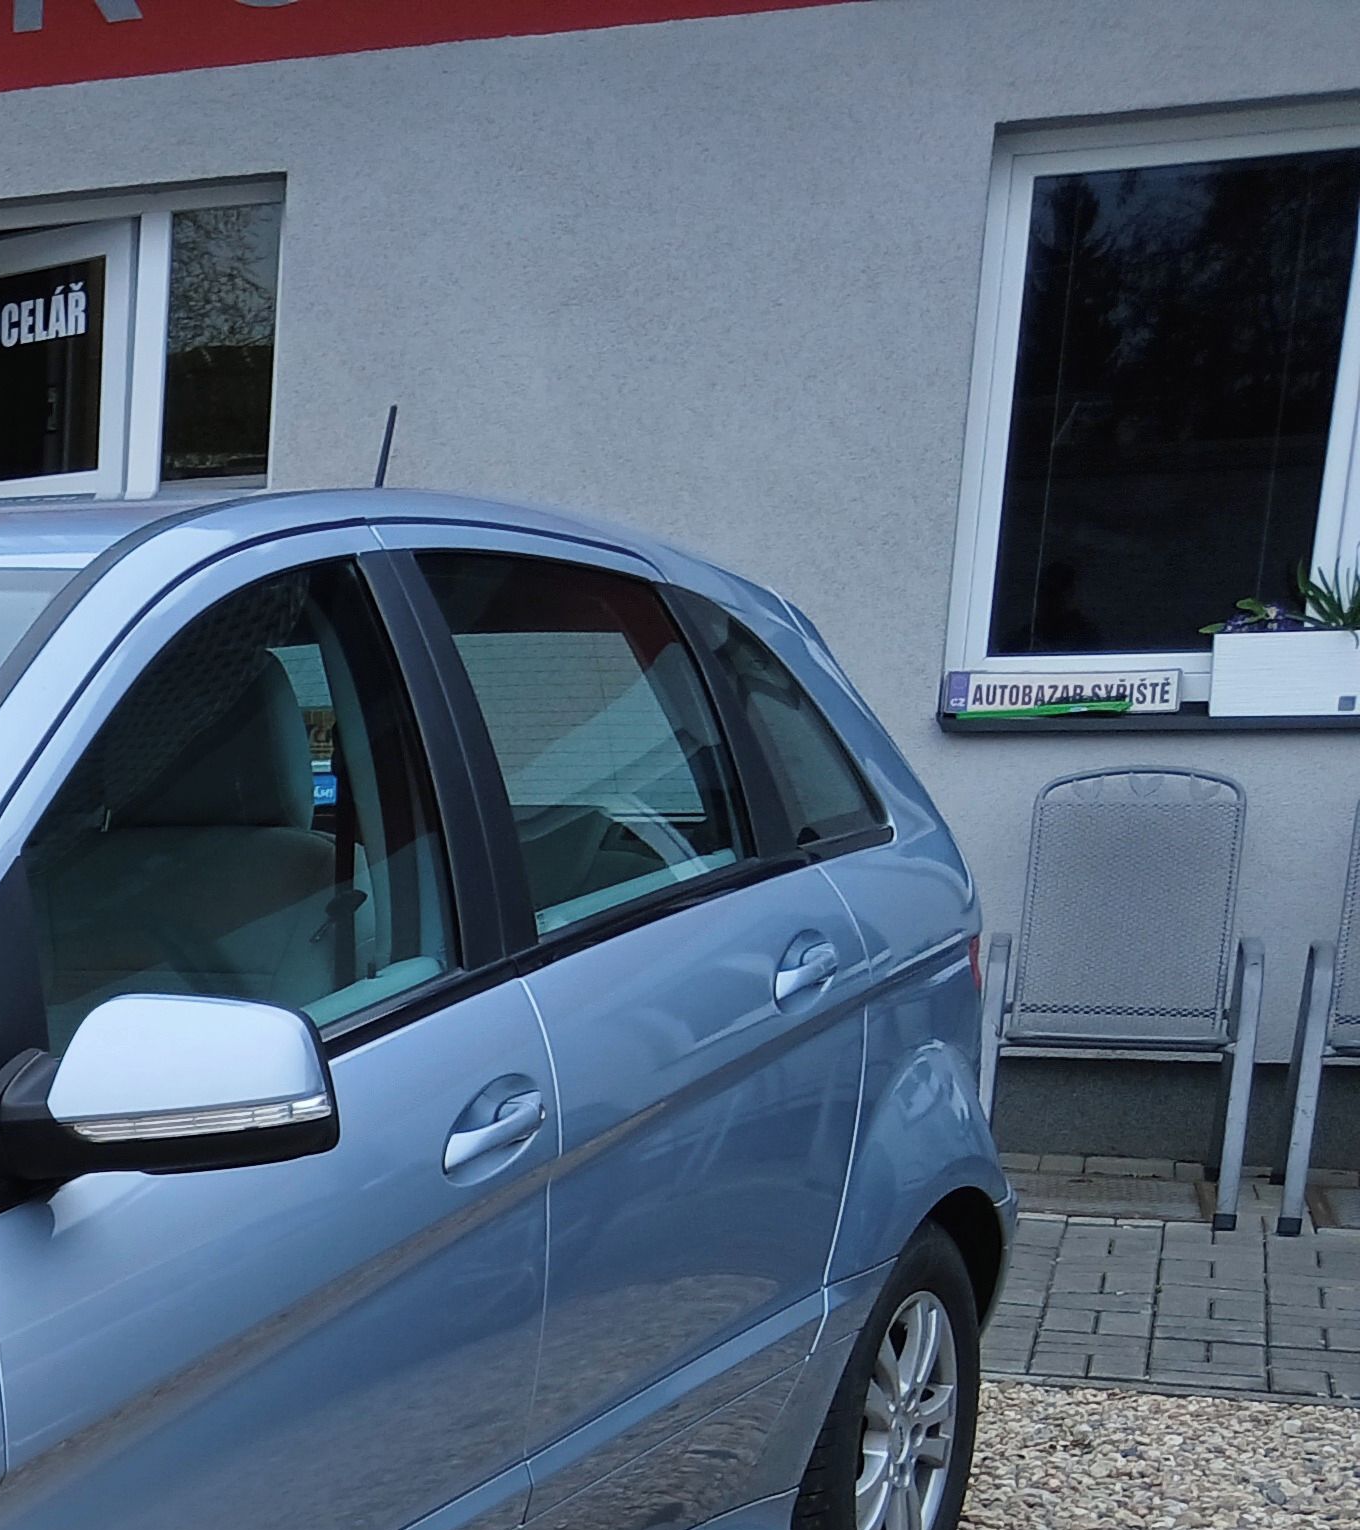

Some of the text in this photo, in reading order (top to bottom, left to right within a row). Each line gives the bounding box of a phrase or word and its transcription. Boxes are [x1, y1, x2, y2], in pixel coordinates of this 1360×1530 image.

[950, 677, 1171, 707] CZ AUTOBAZAR SYŘIŠTĚ
